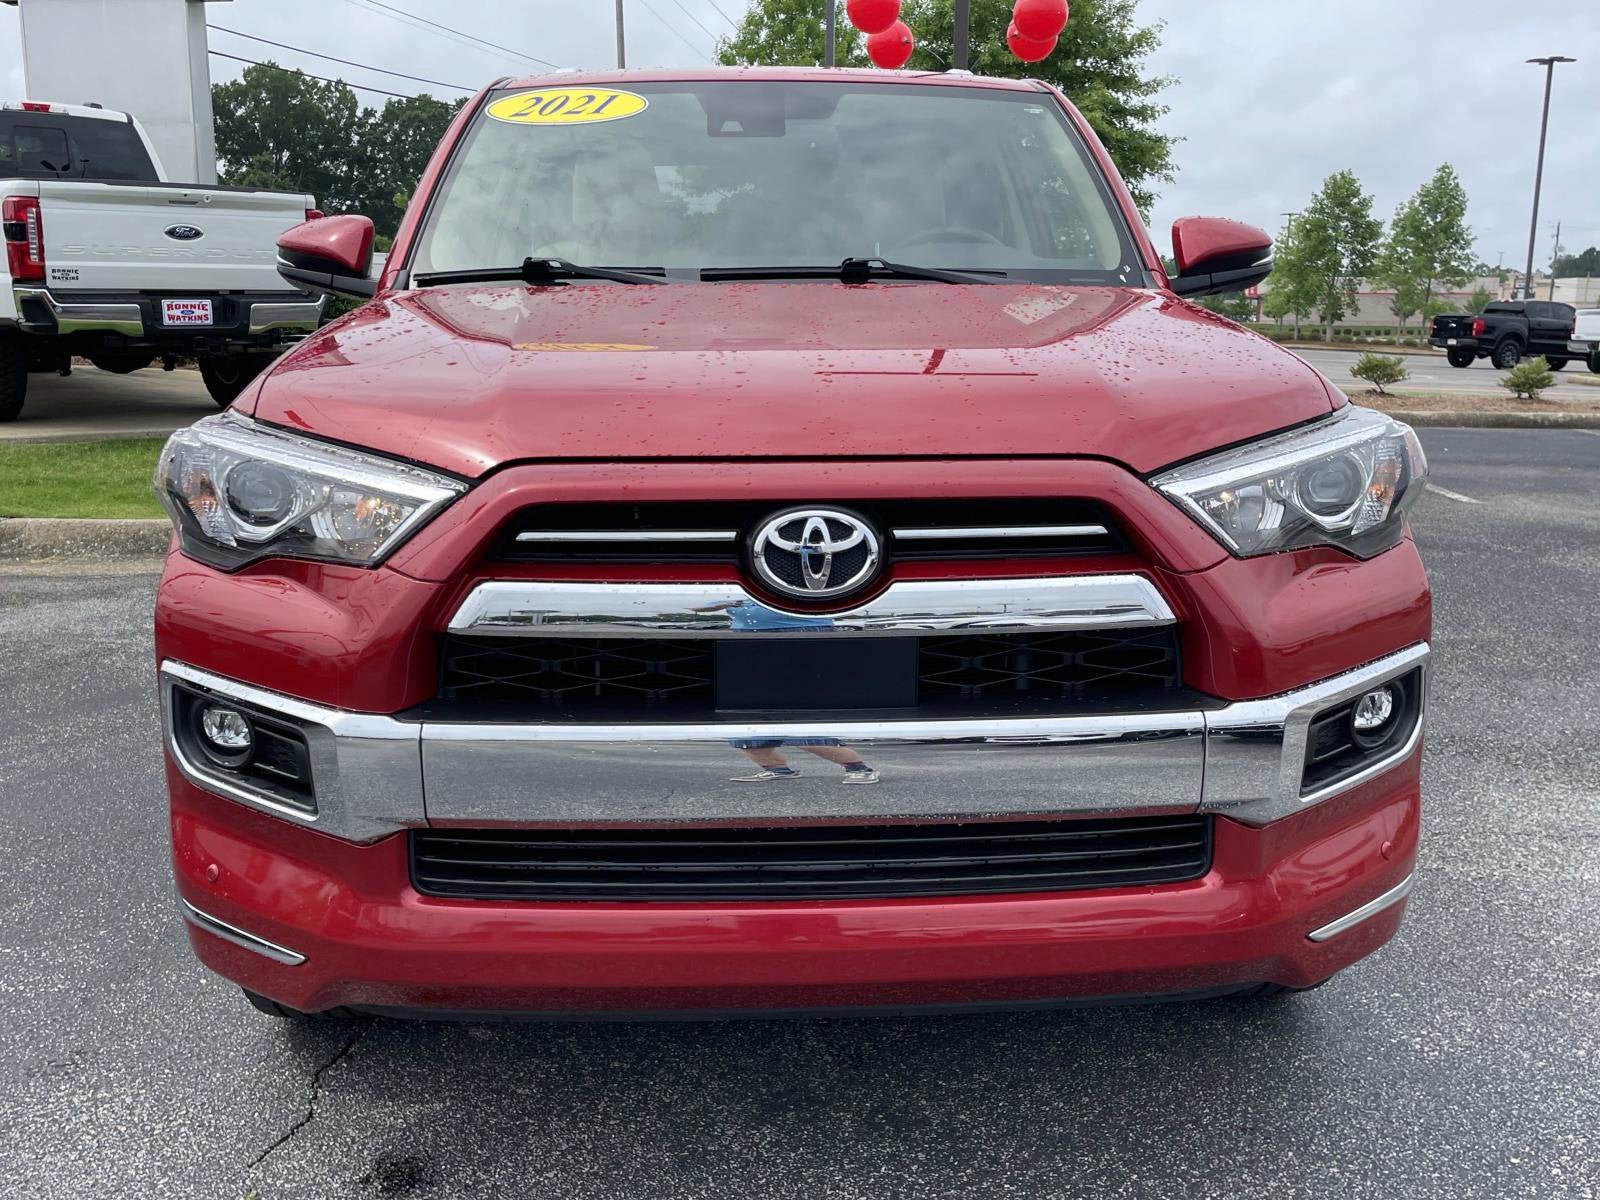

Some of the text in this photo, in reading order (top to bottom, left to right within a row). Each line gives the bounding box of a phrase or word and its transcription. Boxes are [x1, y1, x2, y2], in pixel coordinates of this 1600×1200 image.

[509, 94, 621, 118] 2021
[63, 244, 276, 259] SUPER DUT
[166, 303, 209, 311] RONNIE
[167, 314, 210, 322] WATKINS
